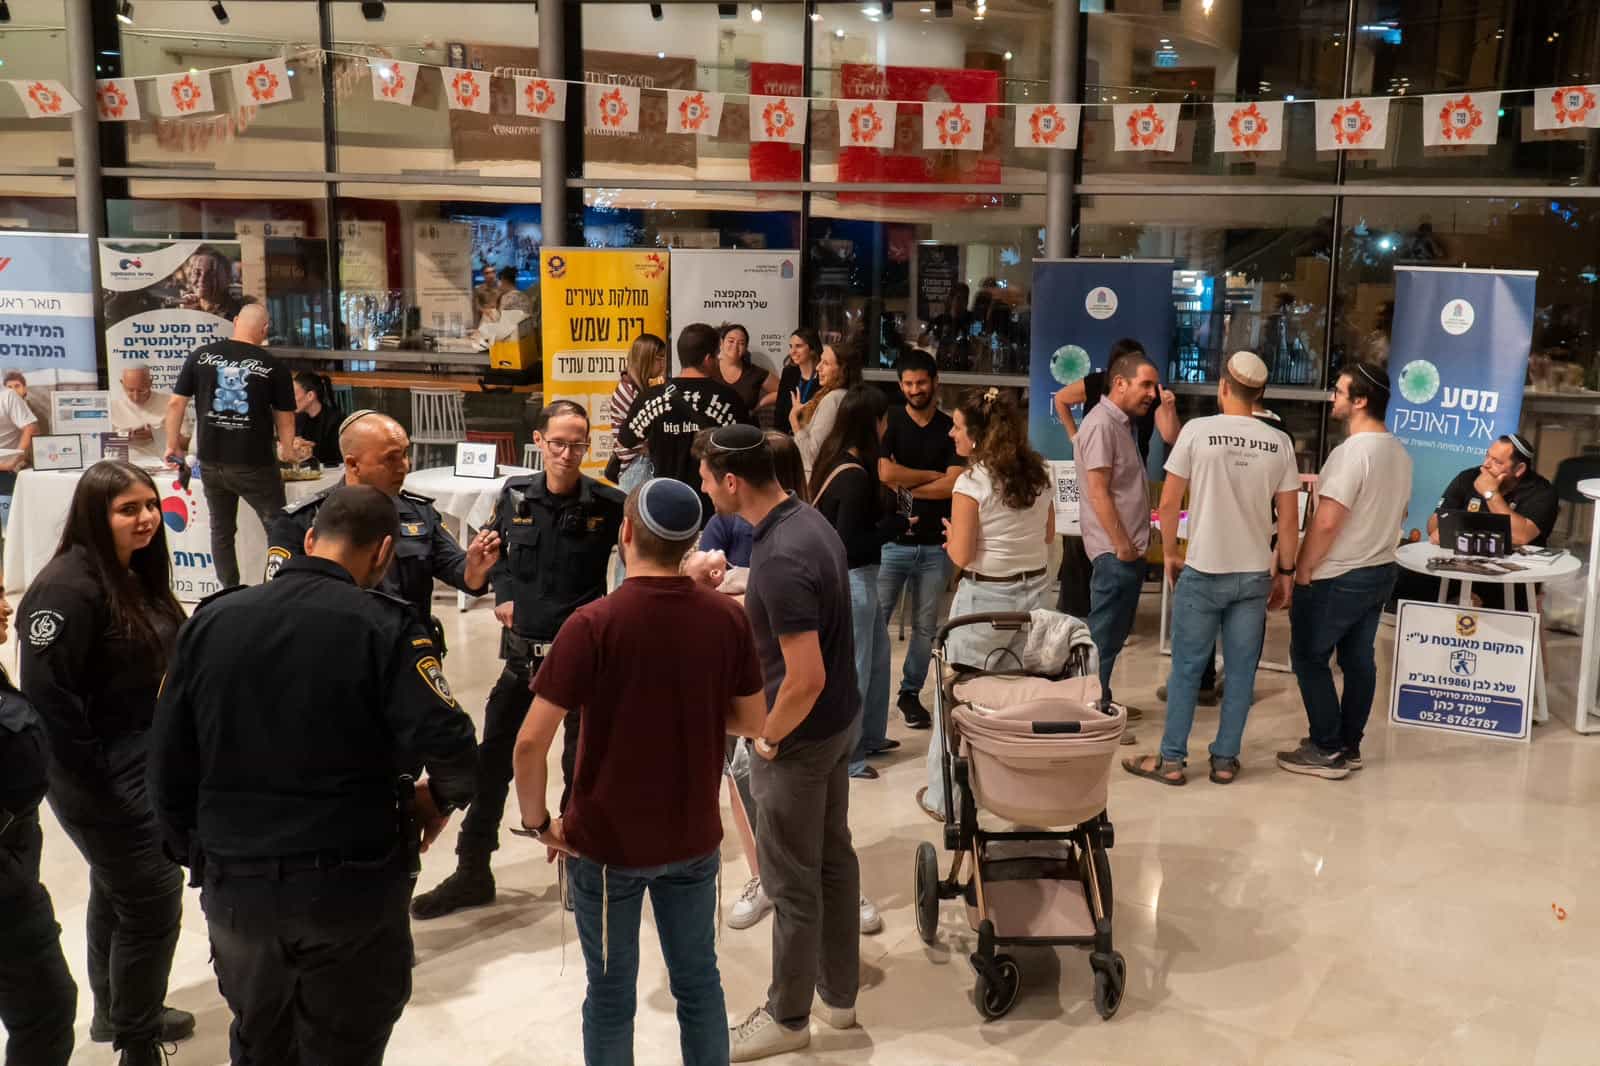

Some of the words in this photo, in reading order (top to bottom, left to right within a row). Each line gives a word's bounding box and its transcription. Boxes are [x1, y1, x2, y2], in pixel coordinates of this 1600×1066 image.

[565, 288, 604, 307] צעירים
[609, 285, 649, 309] מחלקת
[713, 289, 757, 300] המקפצה
[0, 296, 24, 309] ראש
[27, 297, 61, 310] תואר
[703, 298, 744, 309] לאזרחות
[745, 298, 768, 310] שלך
[0, 323, 65, 338] המילואי
[132, 322, 155, 333] של
[160, 323, 192, 334] מסע
[570, 317, 611, 342] שמש
[123, 334, 196, 348] קילומטרים
[0, 343, 66, 359] המהנדס
[240, 359, 273, 374] Real
[557, 356, 584, 374] עתיד
[587, 357, 614, 374] בונים
[1441, 386, 1499, 413] מסע
[1393, 408, 1460, 436] האופק
[1467, 411, 1495, 441] אל
[1208, 435, 1246, 447] לכידות
[1250, 439, 1279, 453] שבוע
[173, 551, 212, 569] ירות
[176, 580, 193, 592] במ
[1432, 635, 1480, 650] מאובטח
[1483, 641, 1524, 655] המקום
[1473, 678, 1491, 693] לבן
[1433, 699, 1454, 711] כהן
[1457, 702, 1486, 715] שקד
